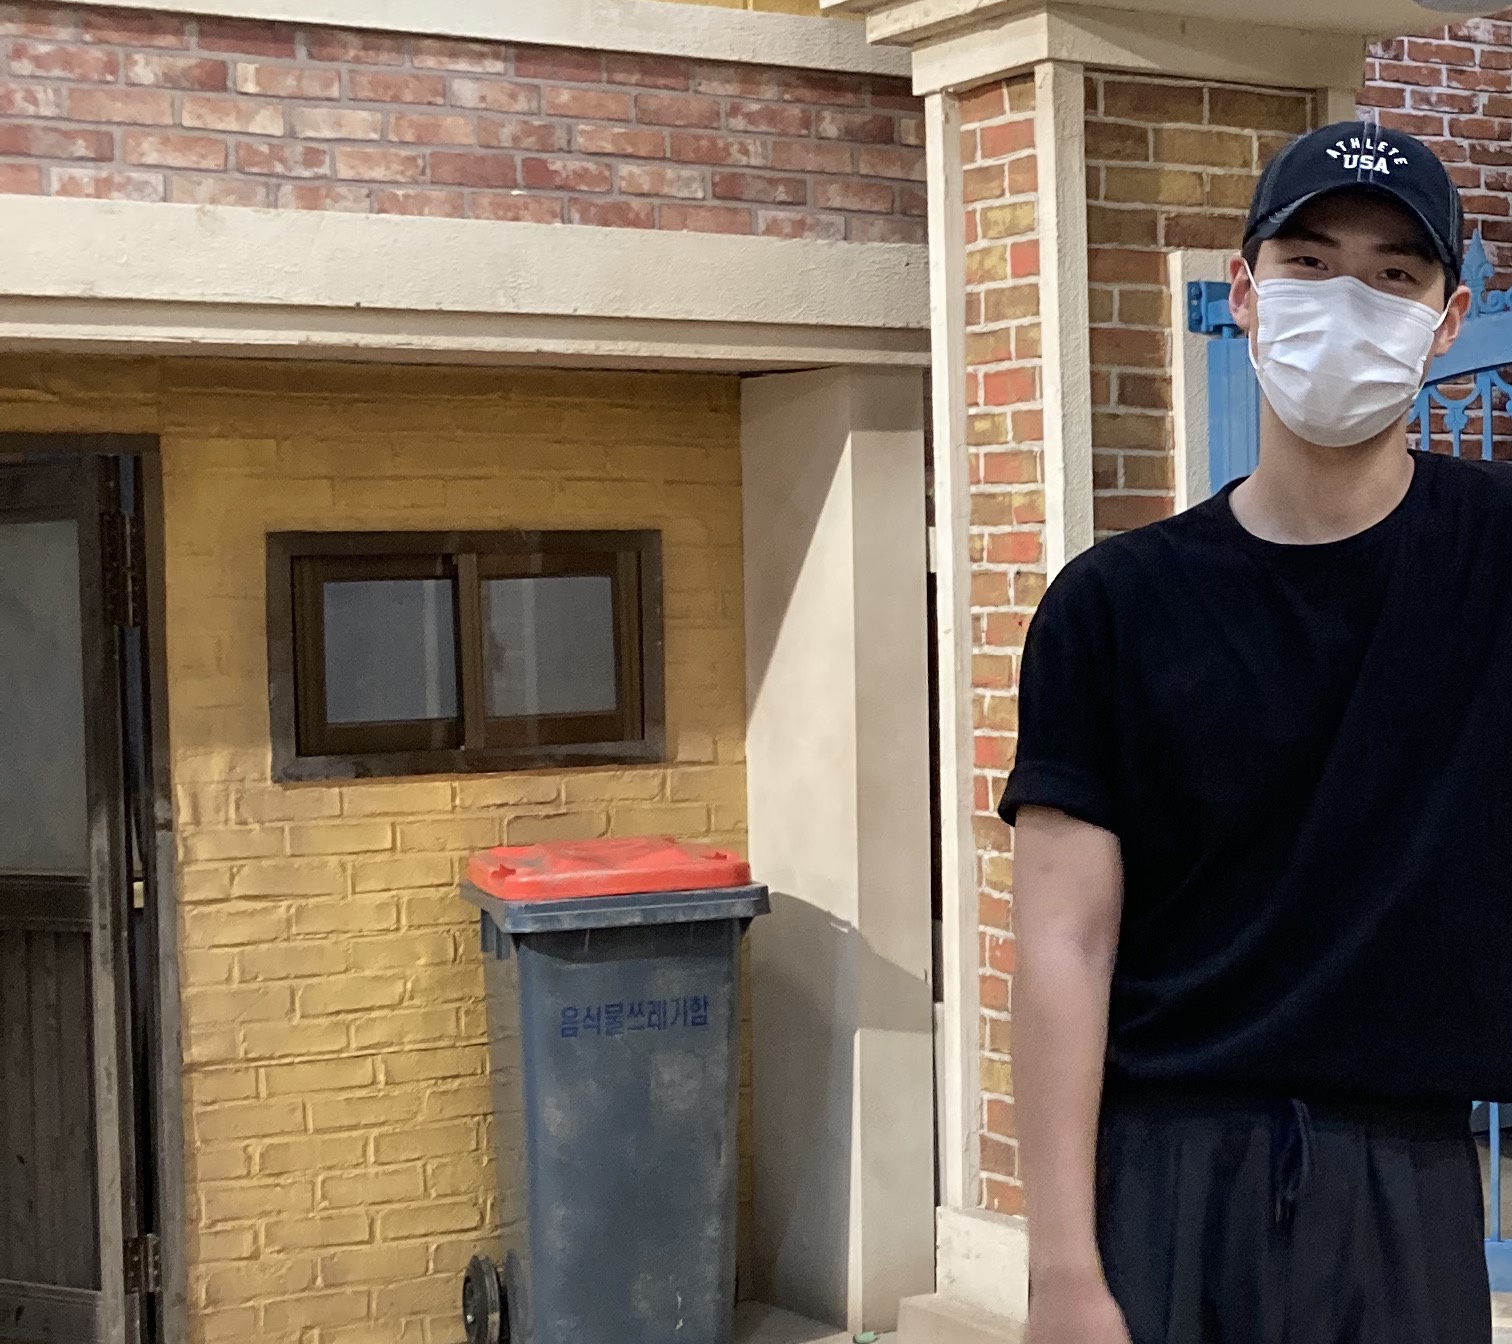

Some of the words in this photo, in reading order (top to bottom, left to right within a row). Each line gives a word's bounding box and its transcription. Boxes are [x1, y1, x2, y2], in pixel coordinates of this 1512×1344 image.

[1325, 137, 1409, 167] ATHLETE
[1342, 154, 1391, 175] USA
[560, 994, 709, 1039] 음식물쓰레기함
